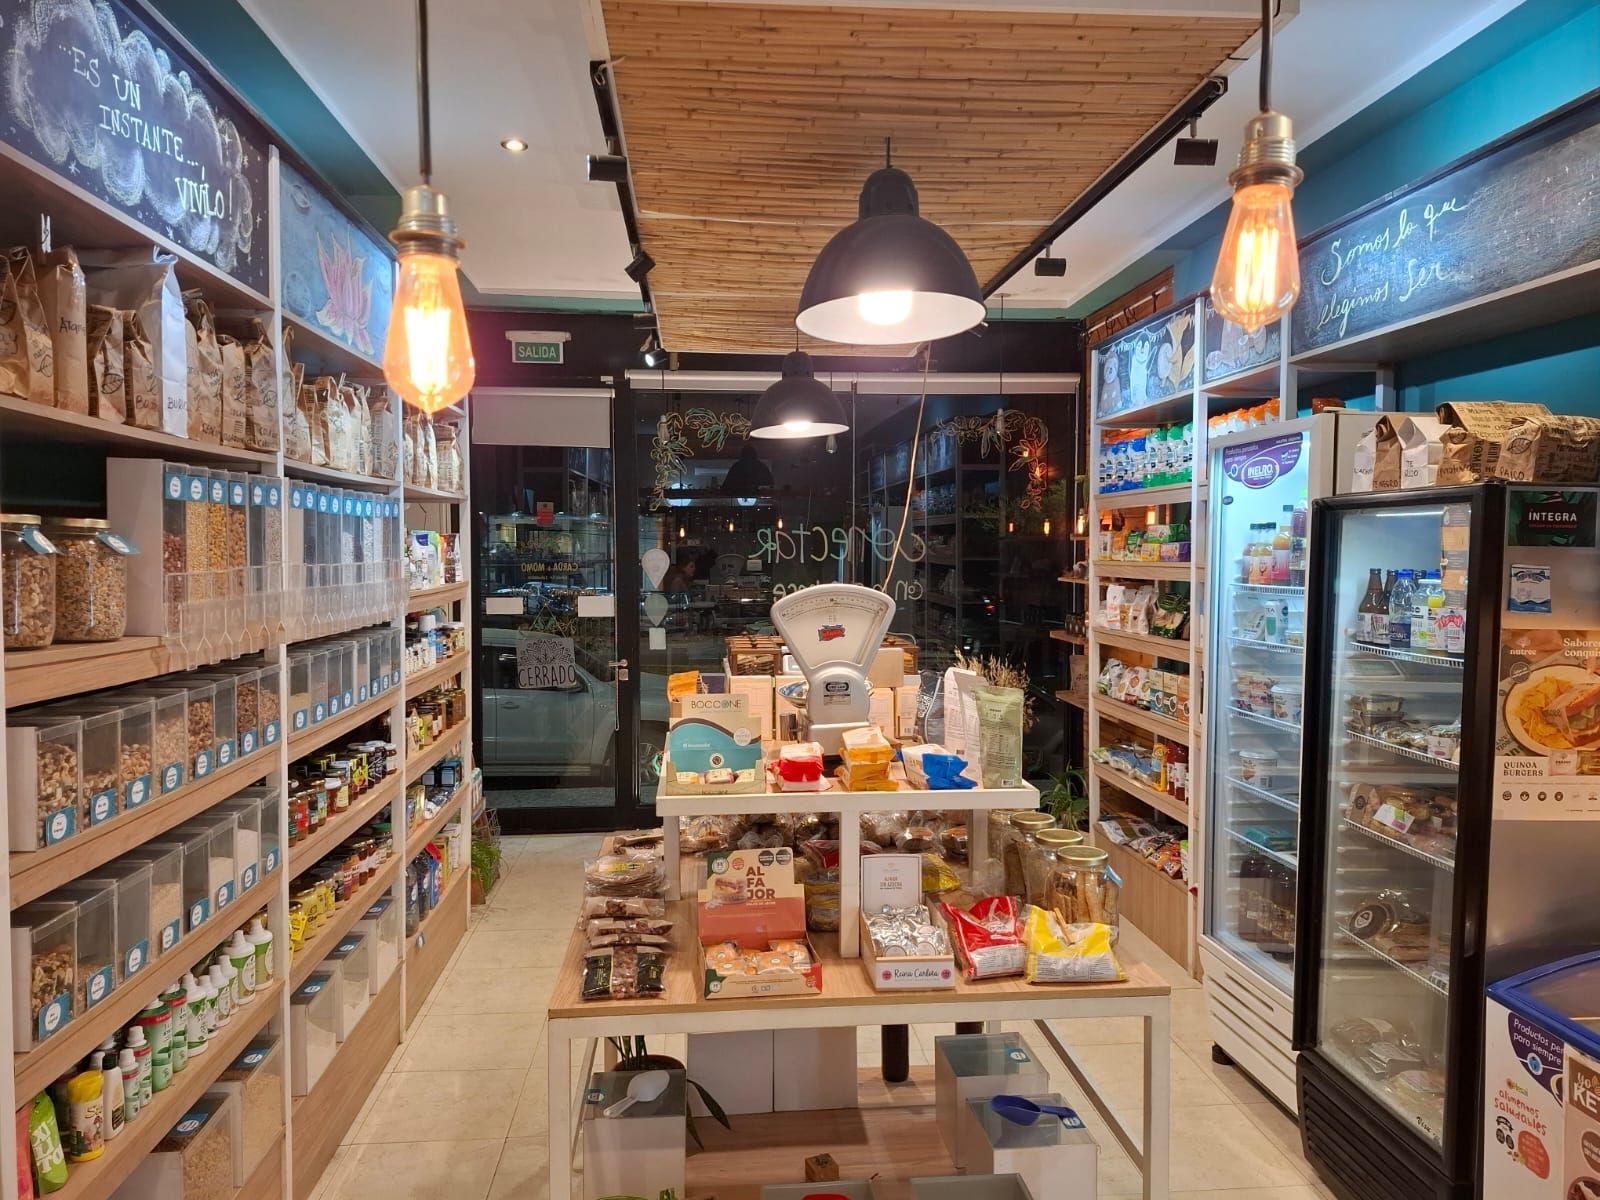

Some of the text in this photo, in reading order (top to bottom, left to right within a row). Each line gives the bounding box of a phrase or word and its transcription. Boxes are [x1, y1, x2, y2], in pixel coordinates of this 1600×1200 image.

[113, 74, 141, 111] UN
[1392, 209, 1419, 249] lo
[1423, 198, 1466, 242] que
[1317, 281, 1390, 338] elegimos
[518, 345, 557, 359] SALIDA
[1379, 479, 1399, 488] NEGRO
[518, 664, 576, 688] CERRADO
[691, 700, 742, 709] BOCCONE
[1503, 761, 1537, 769] QUINOA
[1503, 769, 1544, 777] BURGERS
[746, 866, 765, 876] AL
[746, 877, 765, 888] FA
[746, 888, 776, 900] JOR
[1513, 1018, 1549, 1046] Productos
[1513, 1033, 1561, 1065] para siempre
